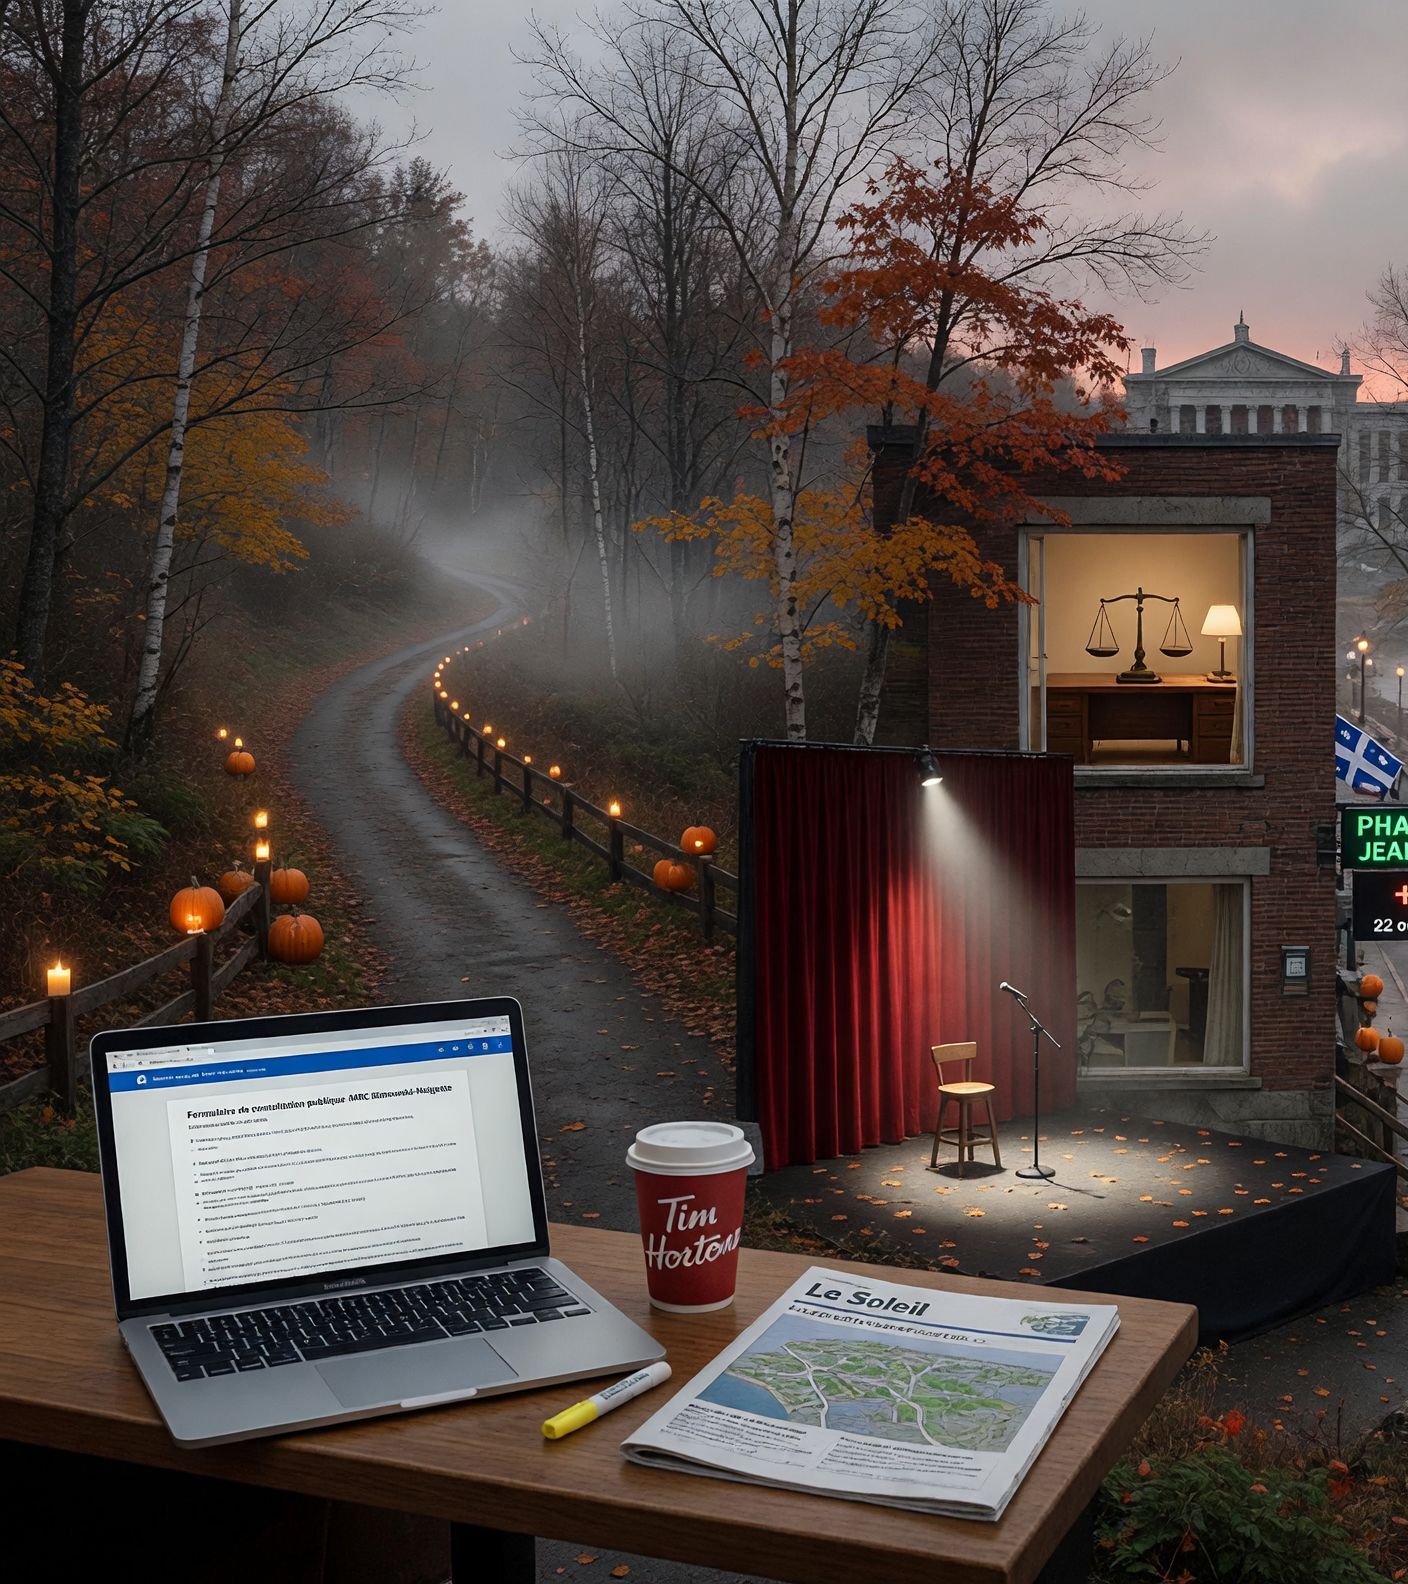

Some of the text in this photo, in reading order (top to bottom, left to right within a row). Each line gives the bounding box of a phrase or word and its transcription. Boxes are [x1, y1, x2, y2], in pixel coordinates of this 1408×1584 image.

[1373, 918, 1393, 932] 22
[657, 1194, 718, 1234] Tim
[804, 1282, 842, 1301] Le
[846, 1290, 931, 1317] Soleil
